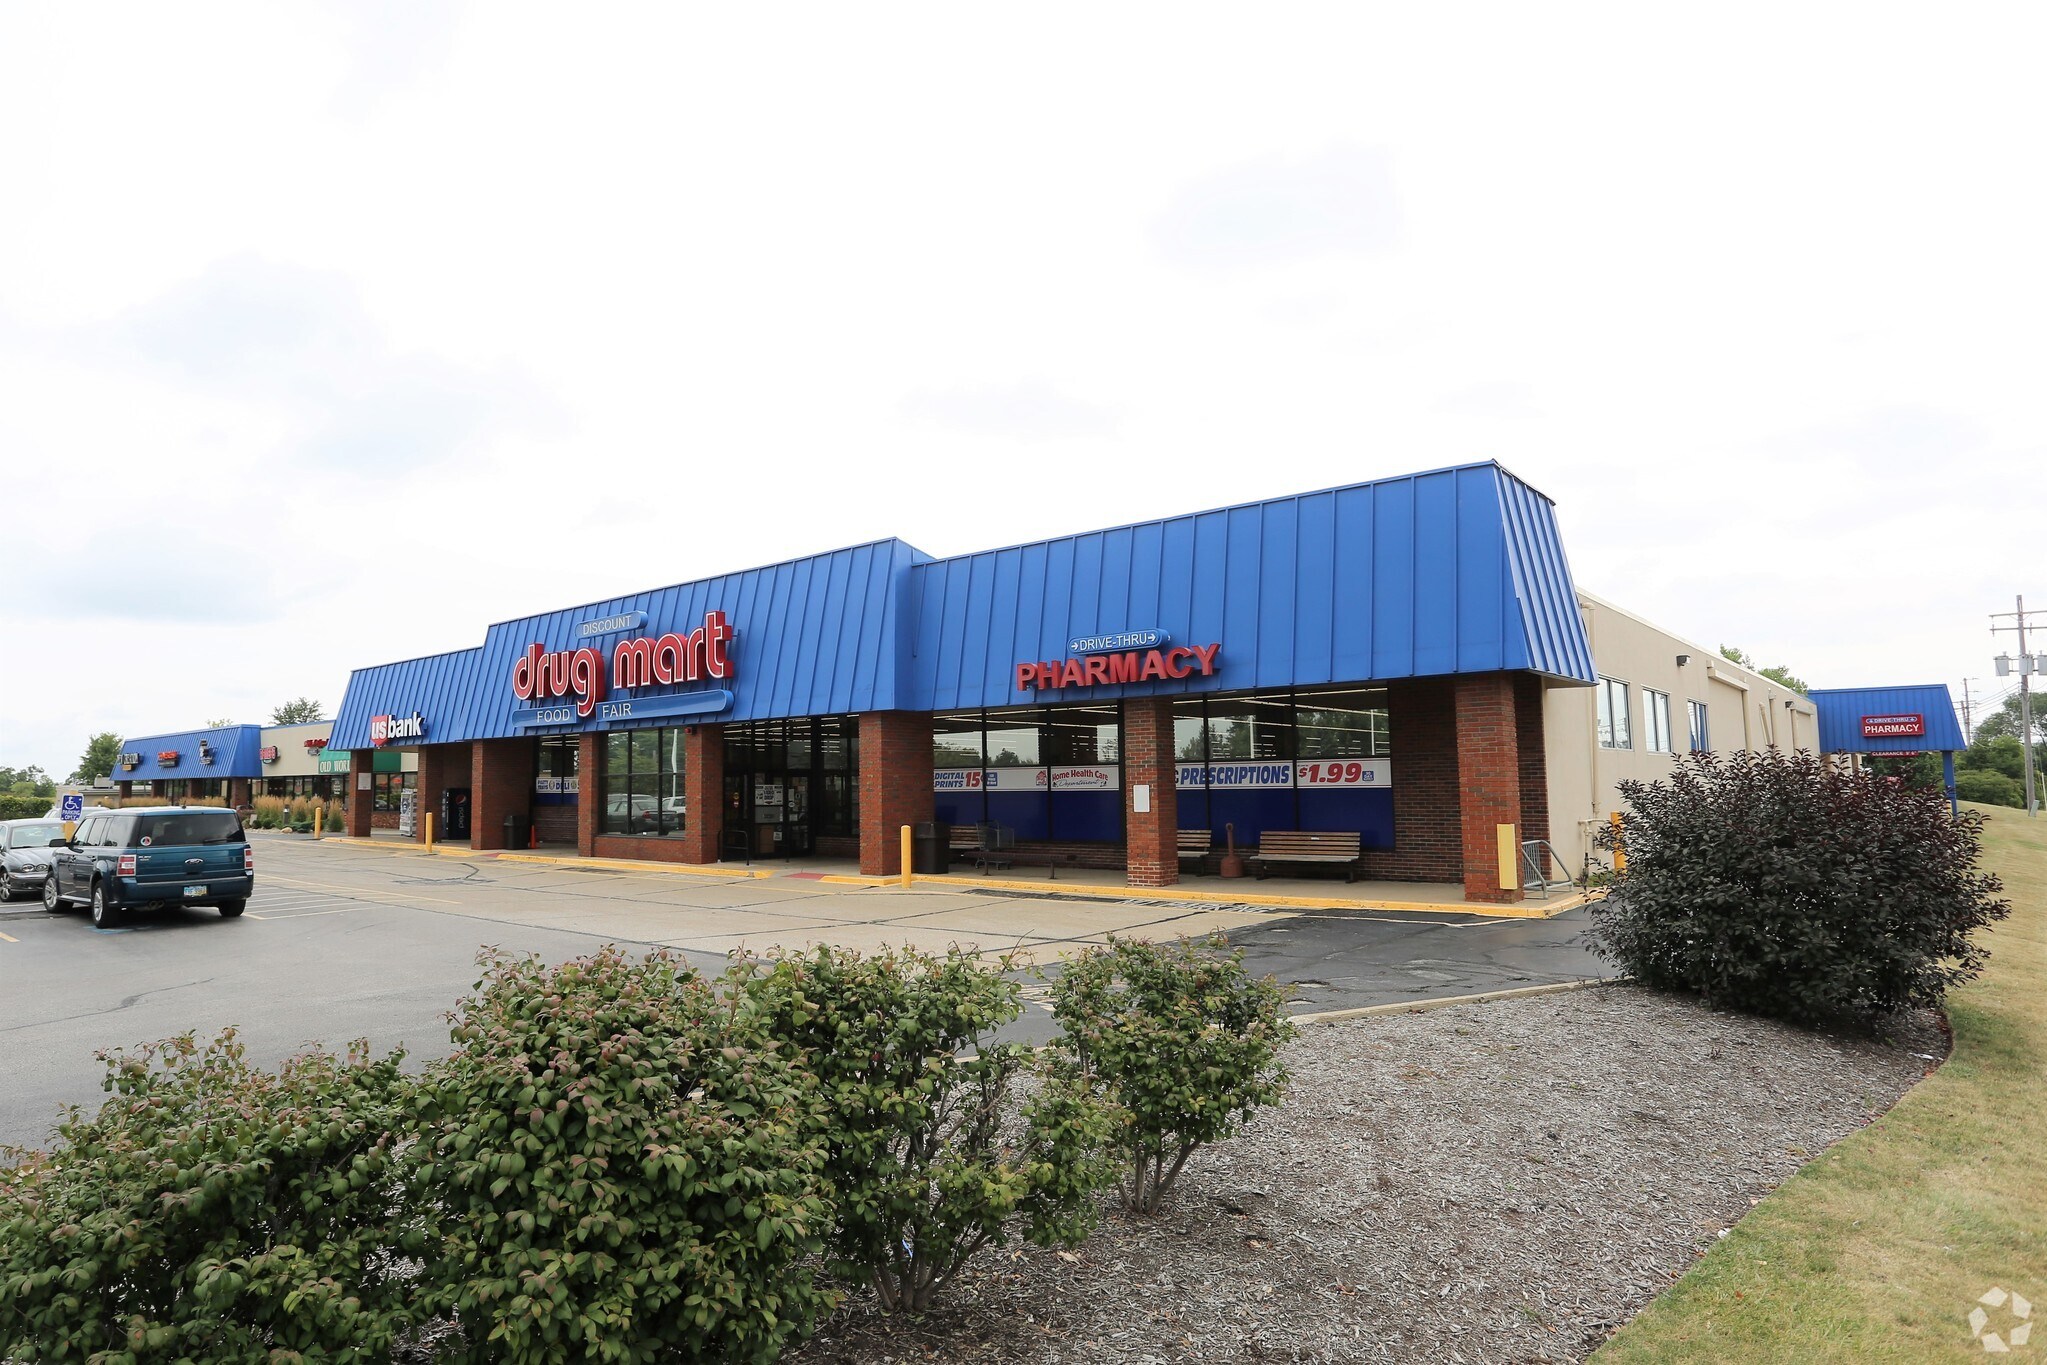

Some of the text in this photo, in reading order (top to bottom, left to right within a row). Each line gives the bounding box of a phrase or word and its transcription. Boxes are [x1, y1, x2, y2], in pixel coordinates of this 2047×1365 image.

[582, 615, 632, 636] DISCOUNT
[1079, 632, 1147, 651] DRIVE-THRU
[513, 611, 732, 717] drug mart
[1016, 643, 1221, 691] PHARMACY
[536, 702, 633, 723] FOOD FAIR
[1864, 724, 1920, 733] PHARMACY
[320, 761, 331, 773] OLD
[1180, 765, 1290, 785] PRESCRIPTIONS
[1298, 762, 1362, 783] $1.99
[934, 772, 964, 780] DIGITAL
[1052, 769, 1108, 782] Home Health Care
[556, 782, 570, 790] DLI
[934, 780, 964, 788] PRINTS
